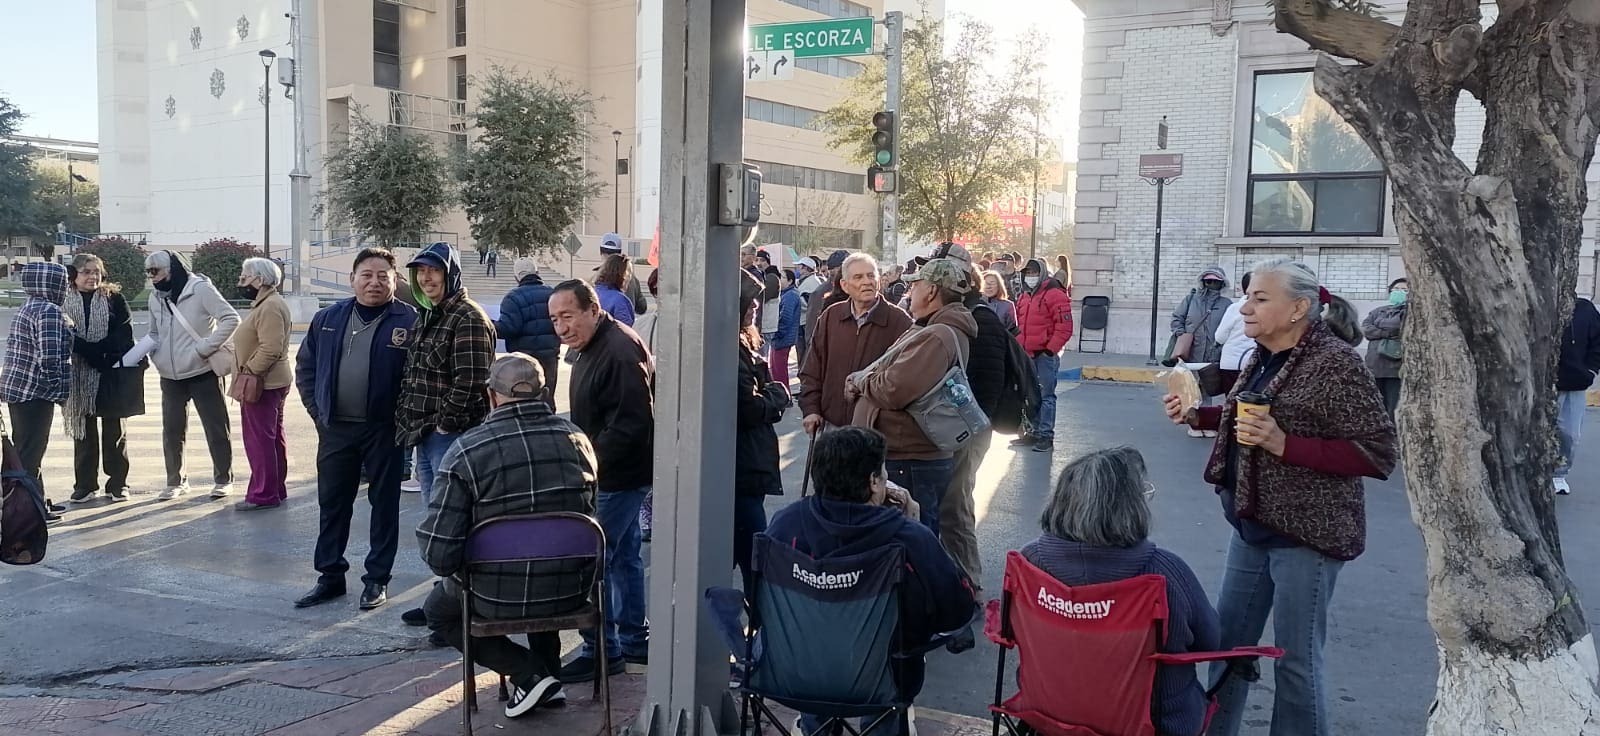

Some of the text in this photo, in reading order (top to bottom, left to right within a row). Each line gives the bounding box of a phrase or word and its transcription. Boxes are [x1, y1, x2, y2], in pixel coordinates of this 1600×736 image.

[783, 28, 864, 50] ESCORZA
[792, 563, 860, 585] Academy
[1038, 587, 1111, 616] Academy
